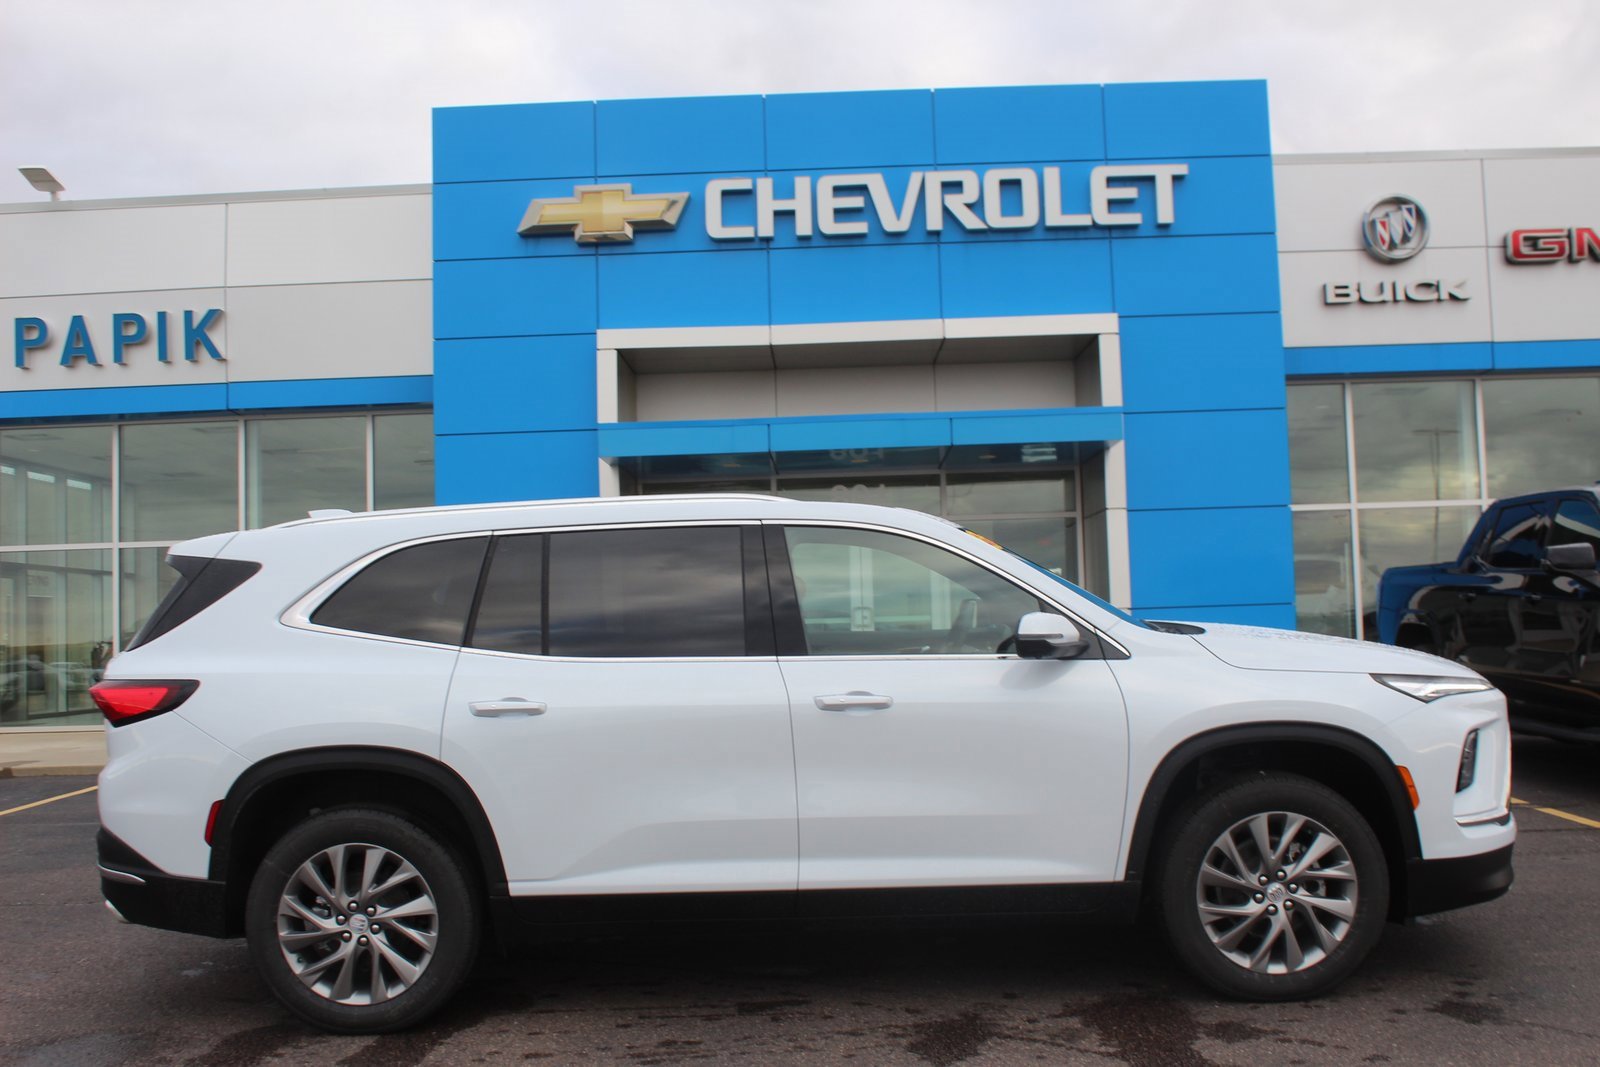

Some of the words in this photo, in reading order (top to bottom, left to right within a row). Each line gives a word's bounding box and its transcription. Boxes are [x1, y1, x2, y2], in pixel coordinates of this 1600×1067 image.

[705, 164, 1189, 240] CHEVROLET
[1324, 279, 1470, 304] BUICK
[15, 309, 225, 369] PAPIK
